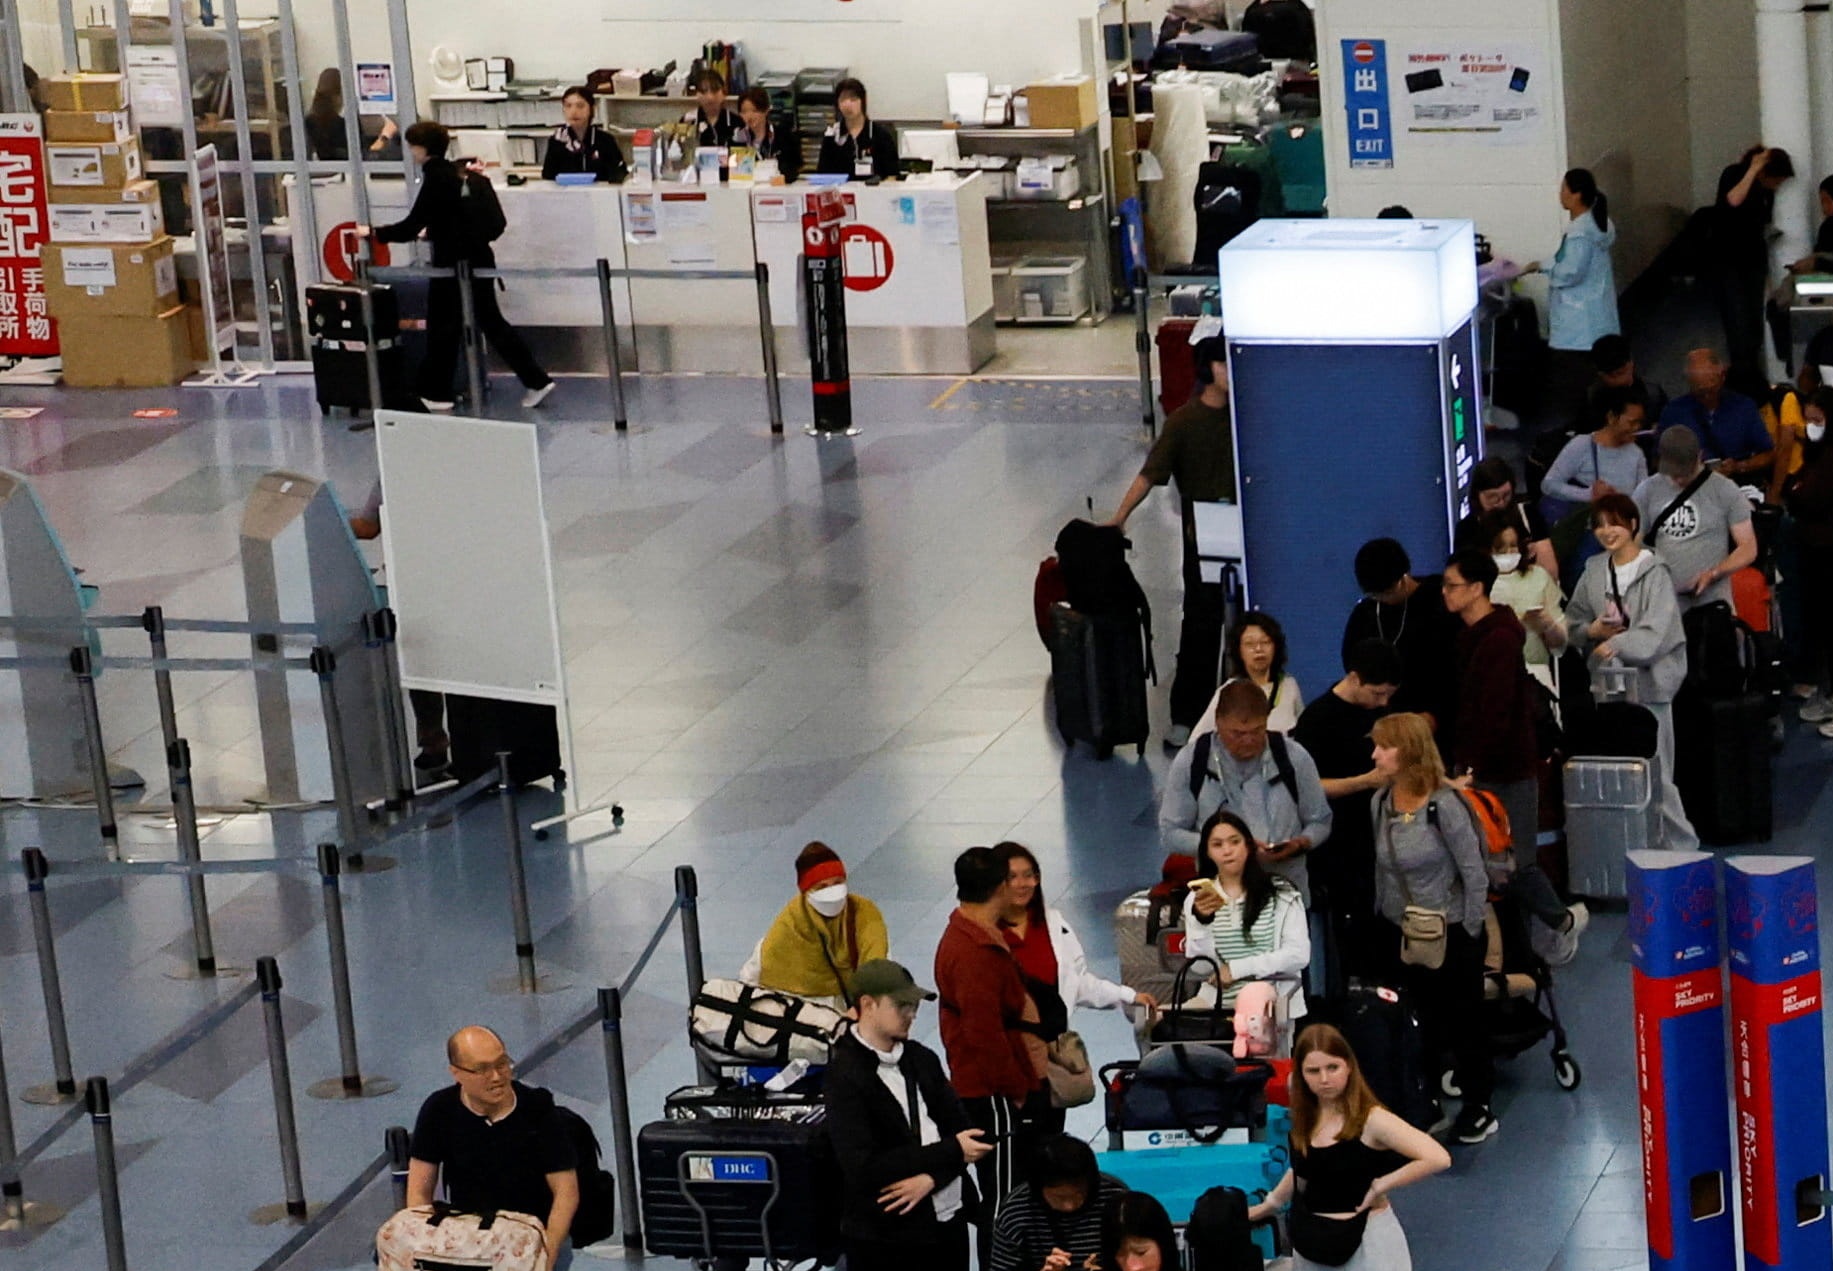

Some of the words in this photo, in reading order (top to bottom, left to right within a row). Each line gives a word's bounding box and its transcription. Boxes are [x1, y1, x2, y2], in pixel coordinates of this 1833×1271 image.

[1354, 68, 1380, 131] 出口
[1355, 138, 1385, 153] EXIT
[22, 267, 51, 341] 手荷物
[1675, 989, 1692, 1000] SKY
[1675, 993, 1714, 1009] PRIORITY
[1782, 994, 1798, 1005] SKY
[1782, 996, 1816, 1014] PRIORITY
[1741, 1111, 1753, 1212] PRIORITY
